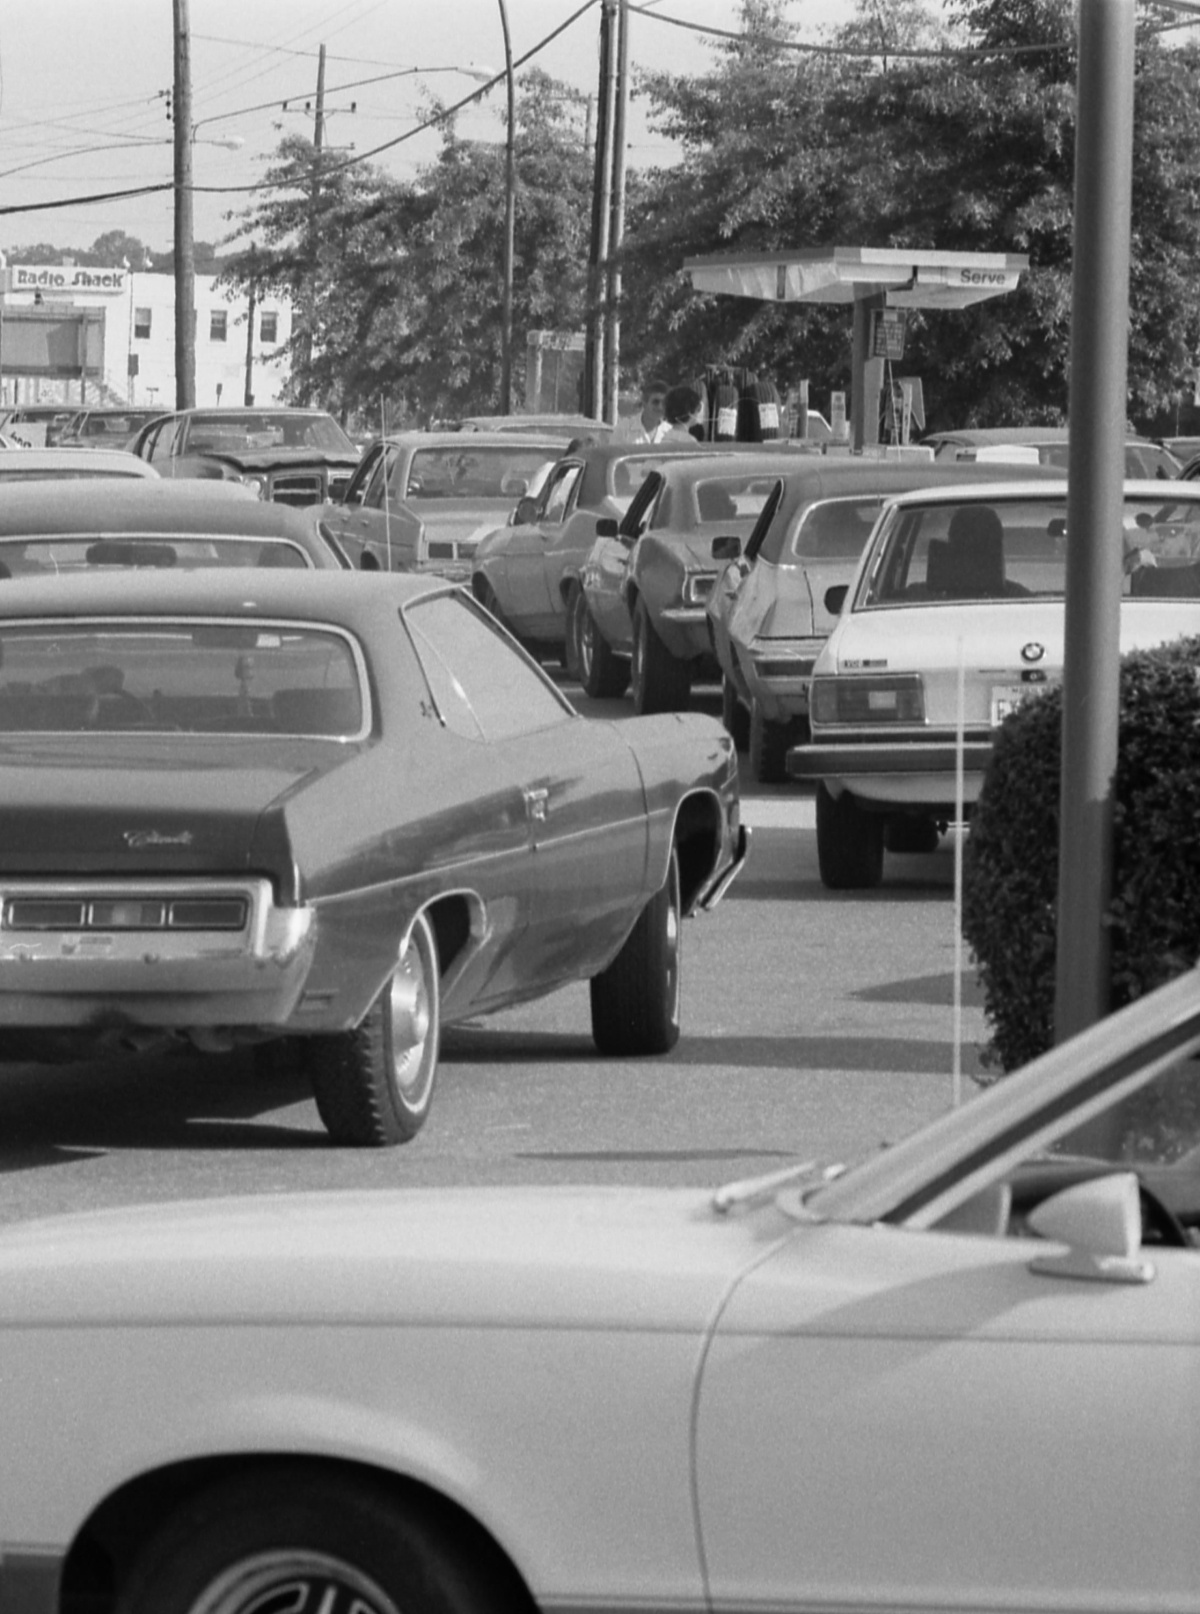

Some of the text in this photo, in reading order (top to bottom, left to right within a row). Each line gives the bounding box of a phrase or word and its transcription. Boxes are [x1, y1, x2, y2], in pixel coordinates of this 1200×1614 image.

[18, 269, 124, 288] Radio Shack
[961, 268, 1006, 285] Serve
